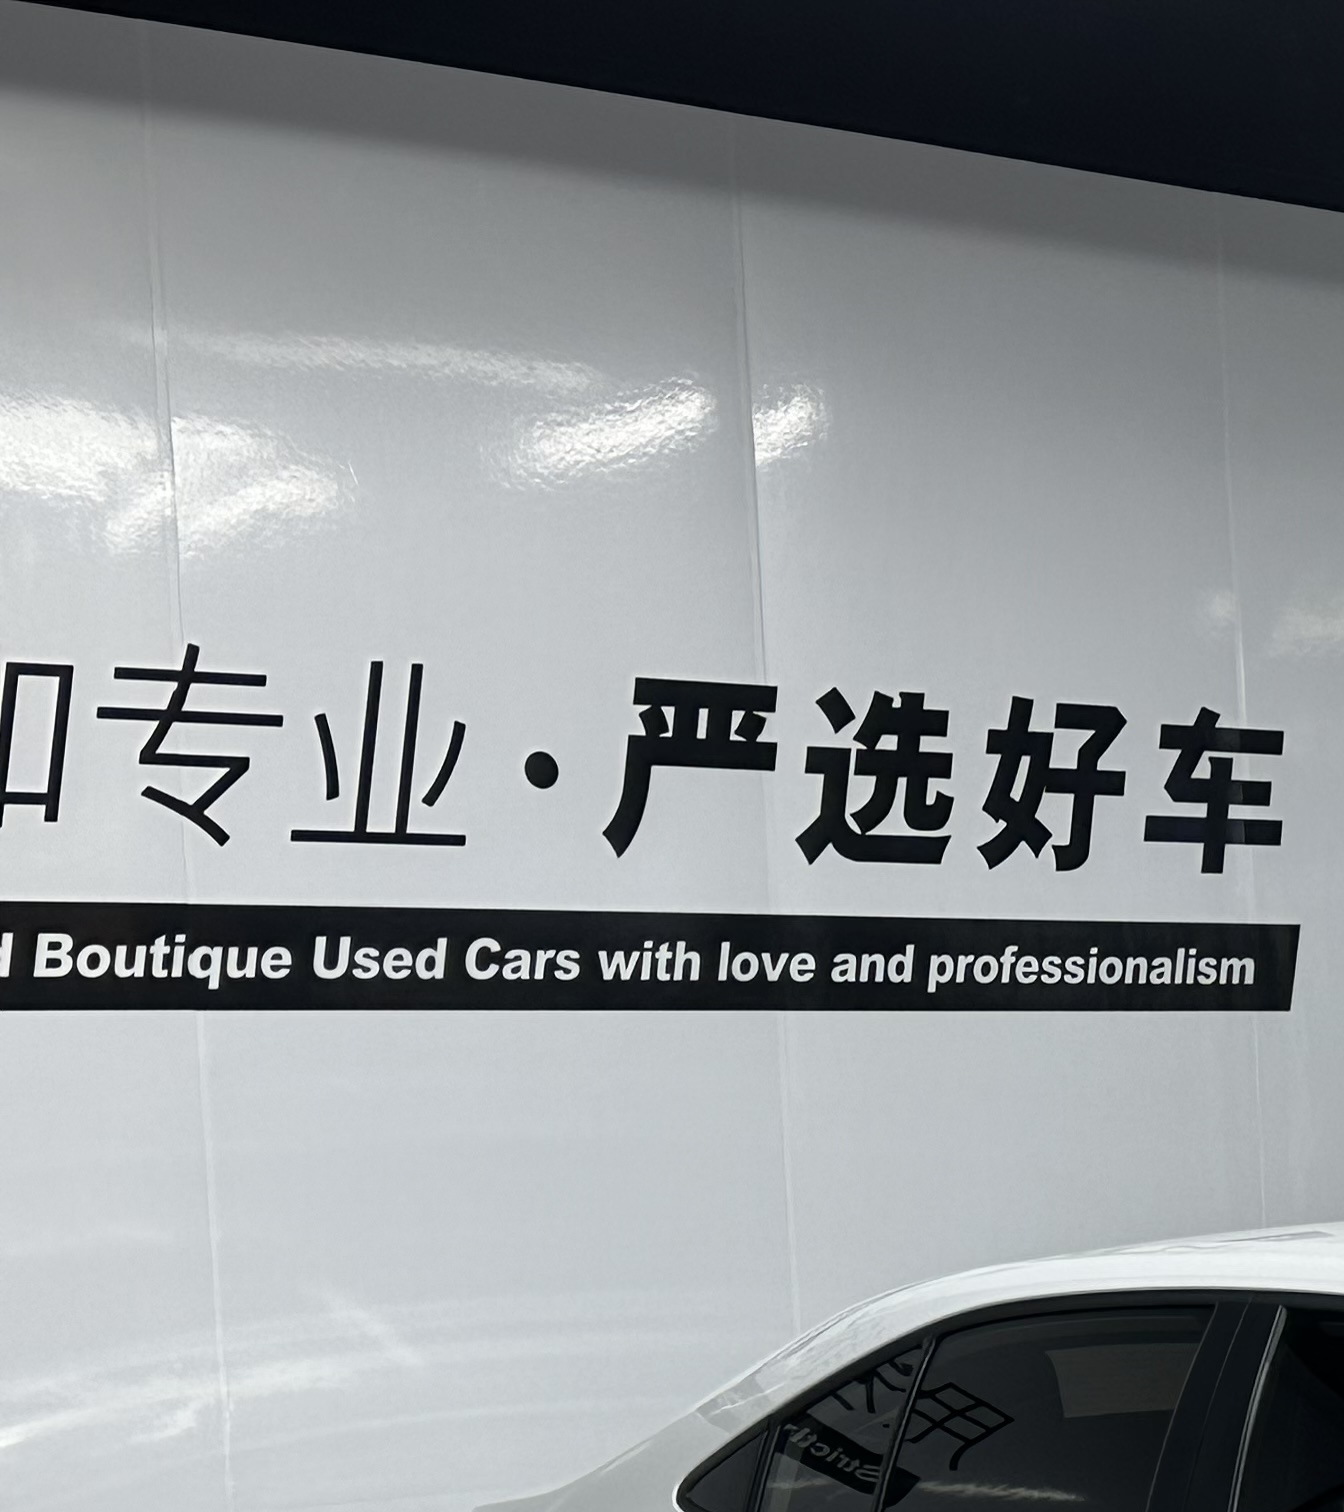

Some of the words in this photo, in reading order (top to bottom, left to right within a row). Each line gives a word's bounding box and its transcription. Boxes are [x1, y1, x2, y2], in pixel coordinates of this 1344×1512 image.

[34, 932, 292, 990] Boutique
[312, 936, 447, 980] Used
[465, 937, 580, 982] Cars
[599, 940, 701, 982] with
[717, 941, 816, 983] love
[831, 945, 914, 984] and
[927, 944, 1256, 993] professionalism
